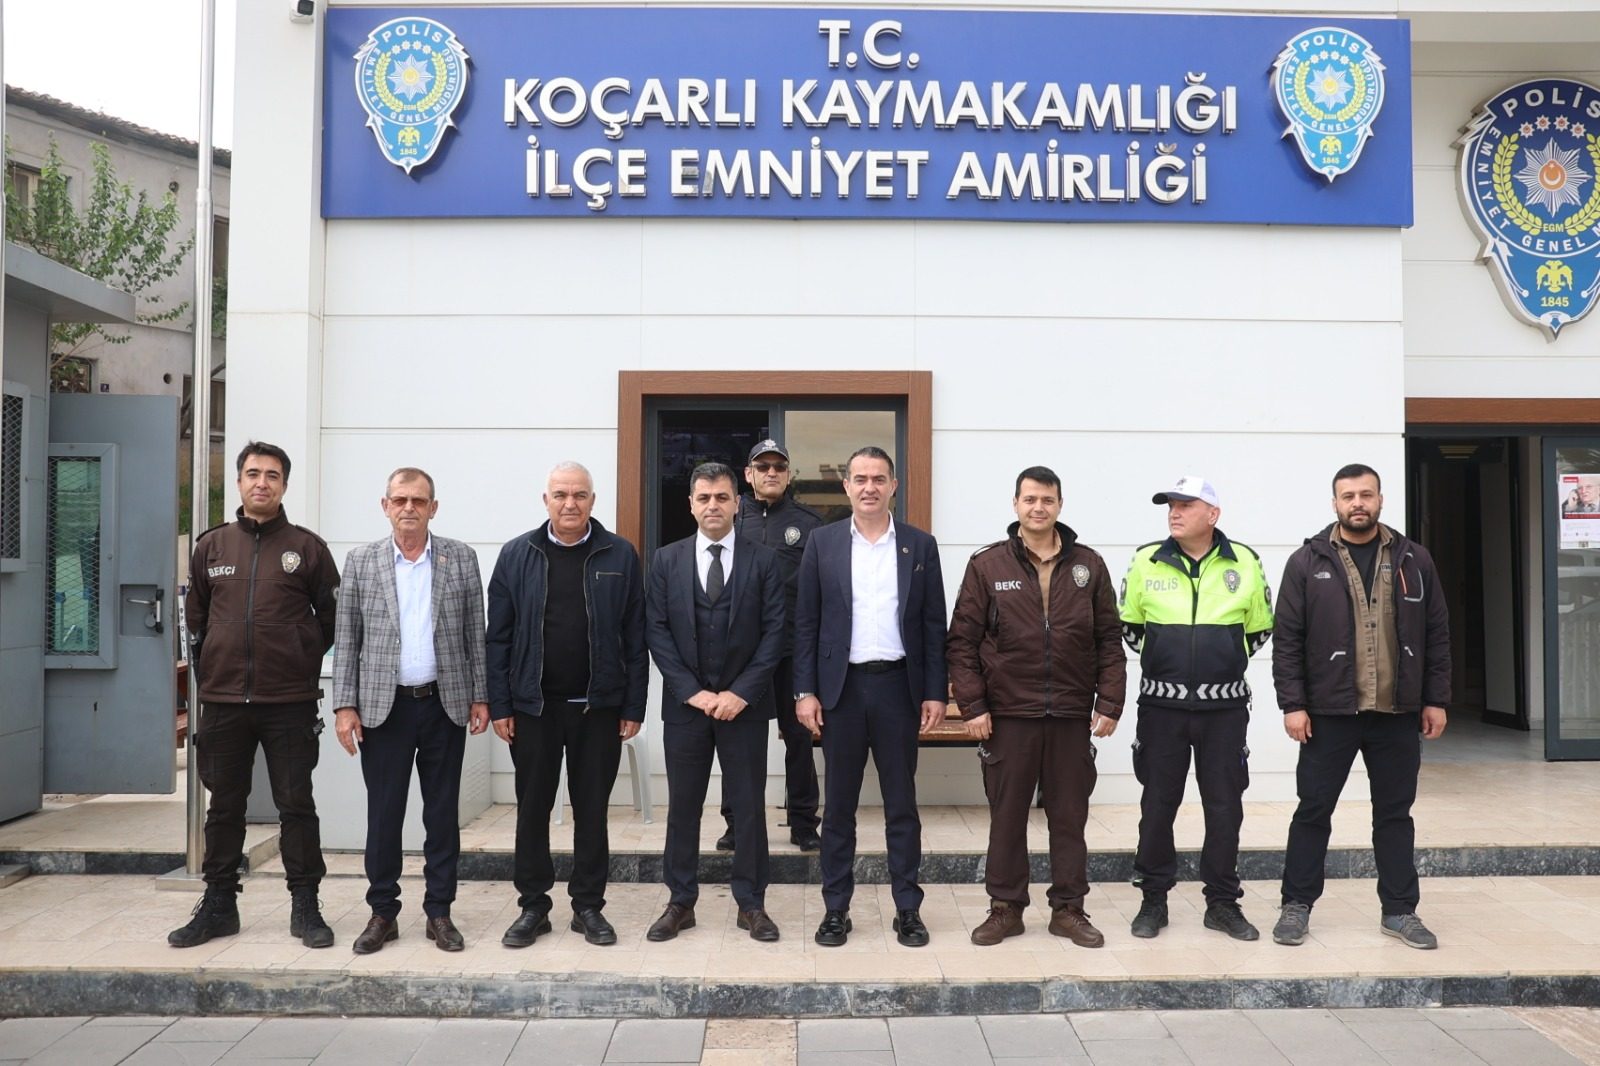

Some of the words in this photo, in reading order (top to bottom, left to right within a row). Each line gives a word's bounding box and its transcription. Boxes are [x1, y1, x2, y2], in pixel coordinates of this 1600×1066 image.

[382, 23, 444, 43] POLİS
[818, 20, 920, 68] T.C.
[1300, 34, 1360, 54] POLİS
[503, 77, 756, 139] KOÇARLI
[782, 72, 1237, 134] KAYMAKAMLIĞI
[1502, 86, 1600, 119] POLİS
[390, 112, 429, 123] GENEL
[1311, 121, 1350, 131] GENEL
[526, 134, 647, 211] İLÇE
[670, 136, 930, 198] EMNİYET
[946, 138, 1207, 204] AMİRLİĞİ
[1477, 126, 1511, 229] EMNİYET
[1521, 235, 1586, 252] GENEL
[1543, 223, 1564, 233] EGM
[1540, 296, 1569, 307] 1845
[207, 565, 236, 578] BEKÇİ
[1145, 577, 1178, 592] POLİS
